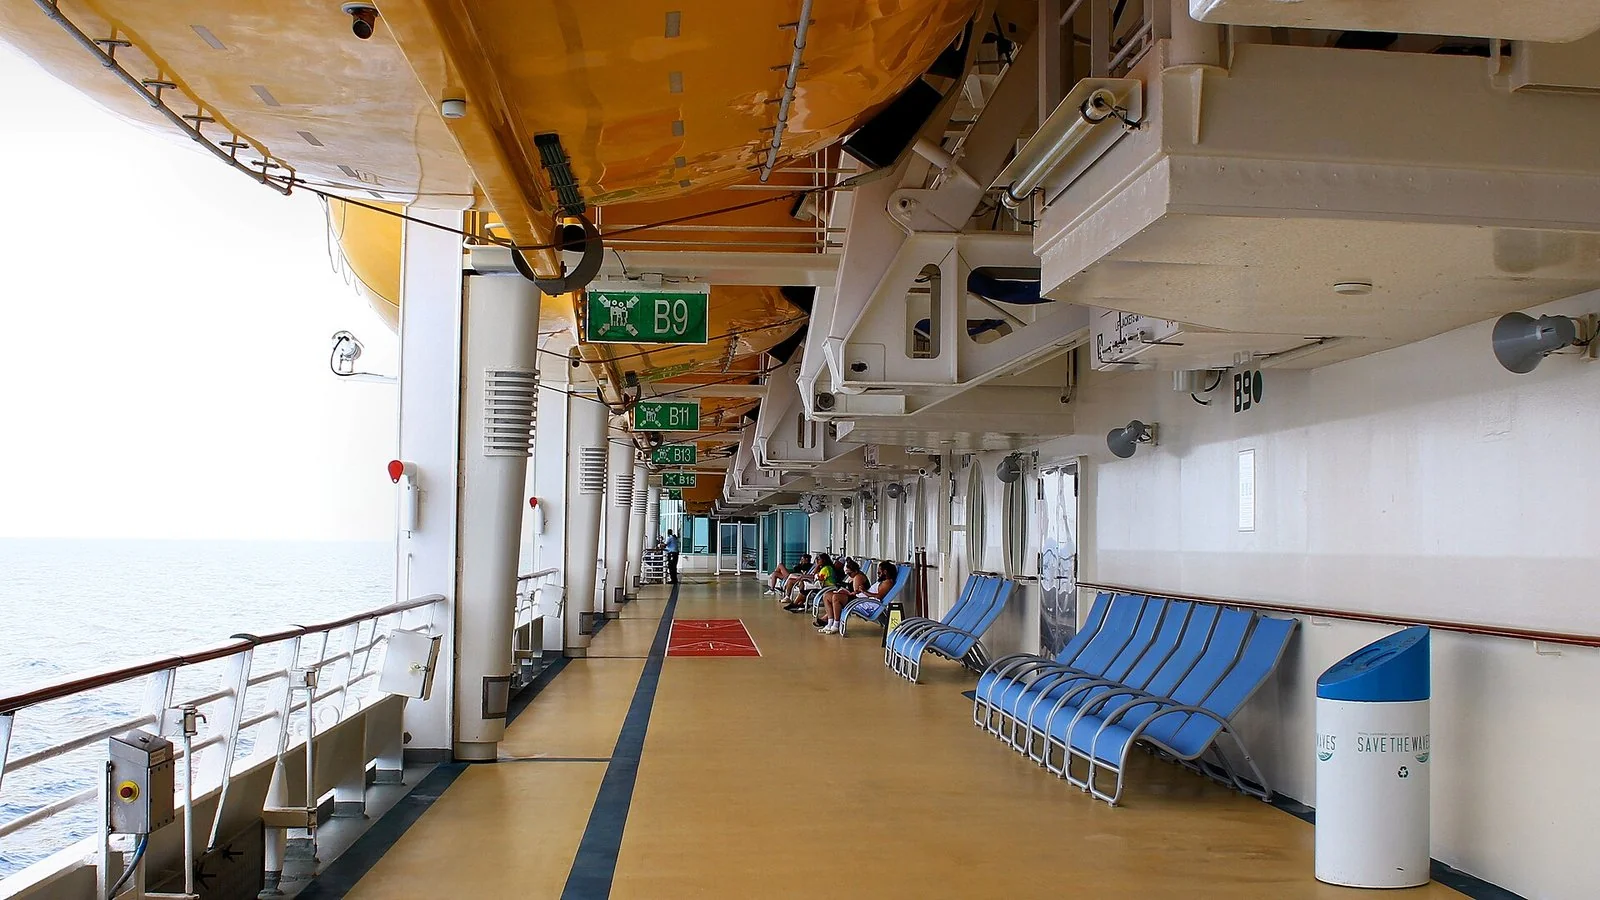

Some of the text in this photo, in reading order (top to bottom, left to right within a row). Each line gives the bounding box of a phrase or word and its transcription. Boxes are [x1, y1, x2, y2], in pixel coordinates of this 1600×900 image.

[654, 299, 688, 335] B9
[1233, 370, 1252, 413] B9
[669, 406, 690, 426] B11
[674, 448, 691, 462] B13
[679, 475, 695, 485] B15
[1357, 734, 1430, 753] SAVE THE WAVE
